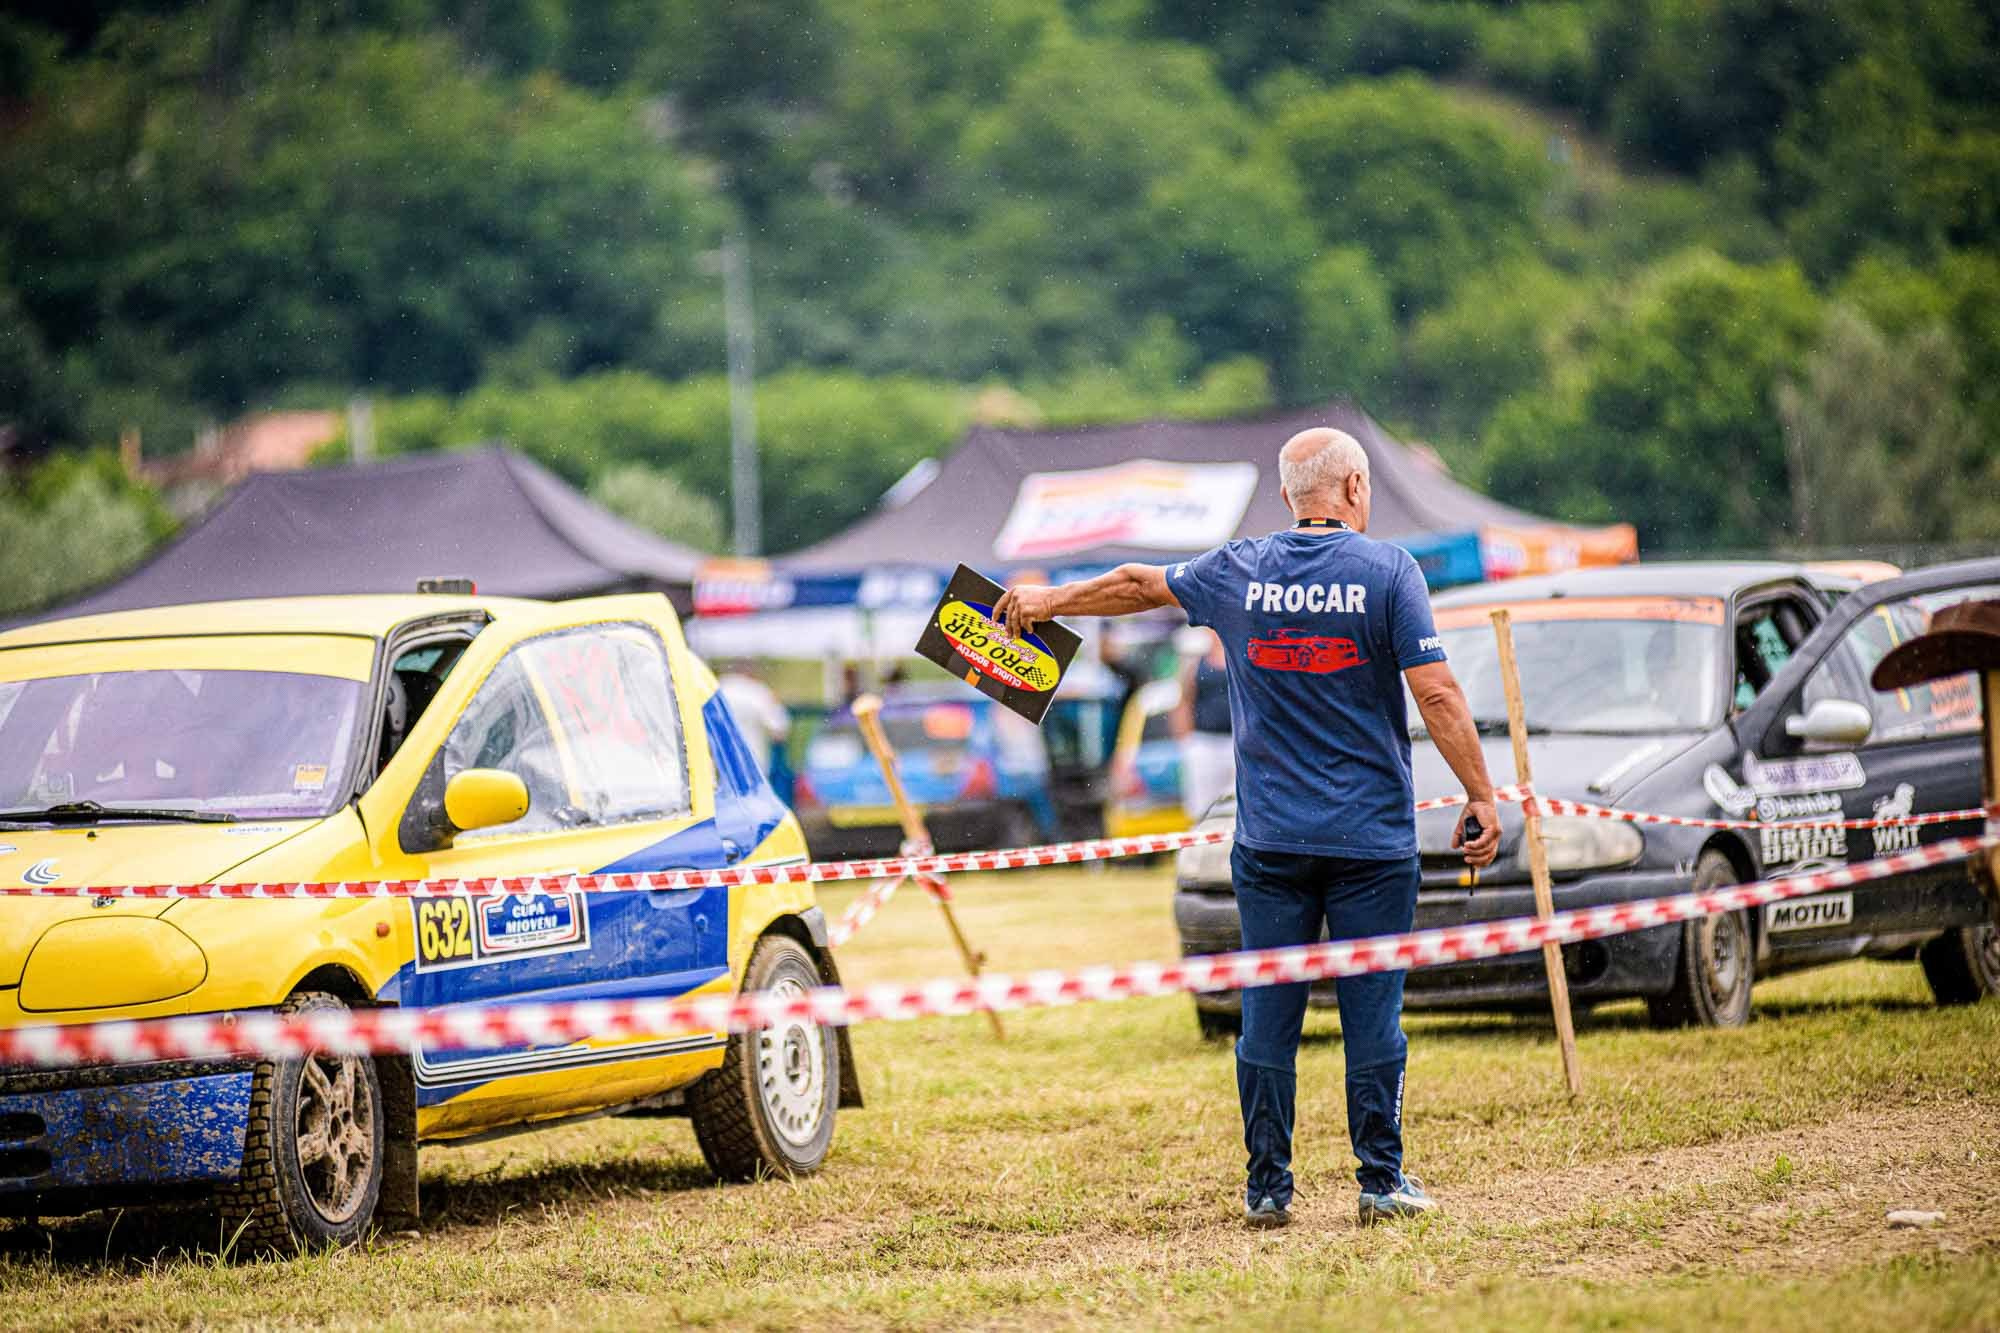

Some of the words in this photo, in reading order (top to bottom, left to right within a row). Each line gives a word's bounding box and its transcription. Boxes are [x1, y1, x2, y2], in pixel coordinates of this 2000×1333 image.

[1244, 581, 1367, 613] PROCAR
[944, 619, 988, 648] CAR
[956, 644, 990, 667] sportiv
[989, 647, 1035, 677] PRO
[991, 664, 1022, 687] clubul
[1761, 839, 1848, 865] BRIDE
[512, 902, 545, 918] CUPA
[1774, 901, 1847, 925] MOTUL
[419, 898, 472, 961] 632
